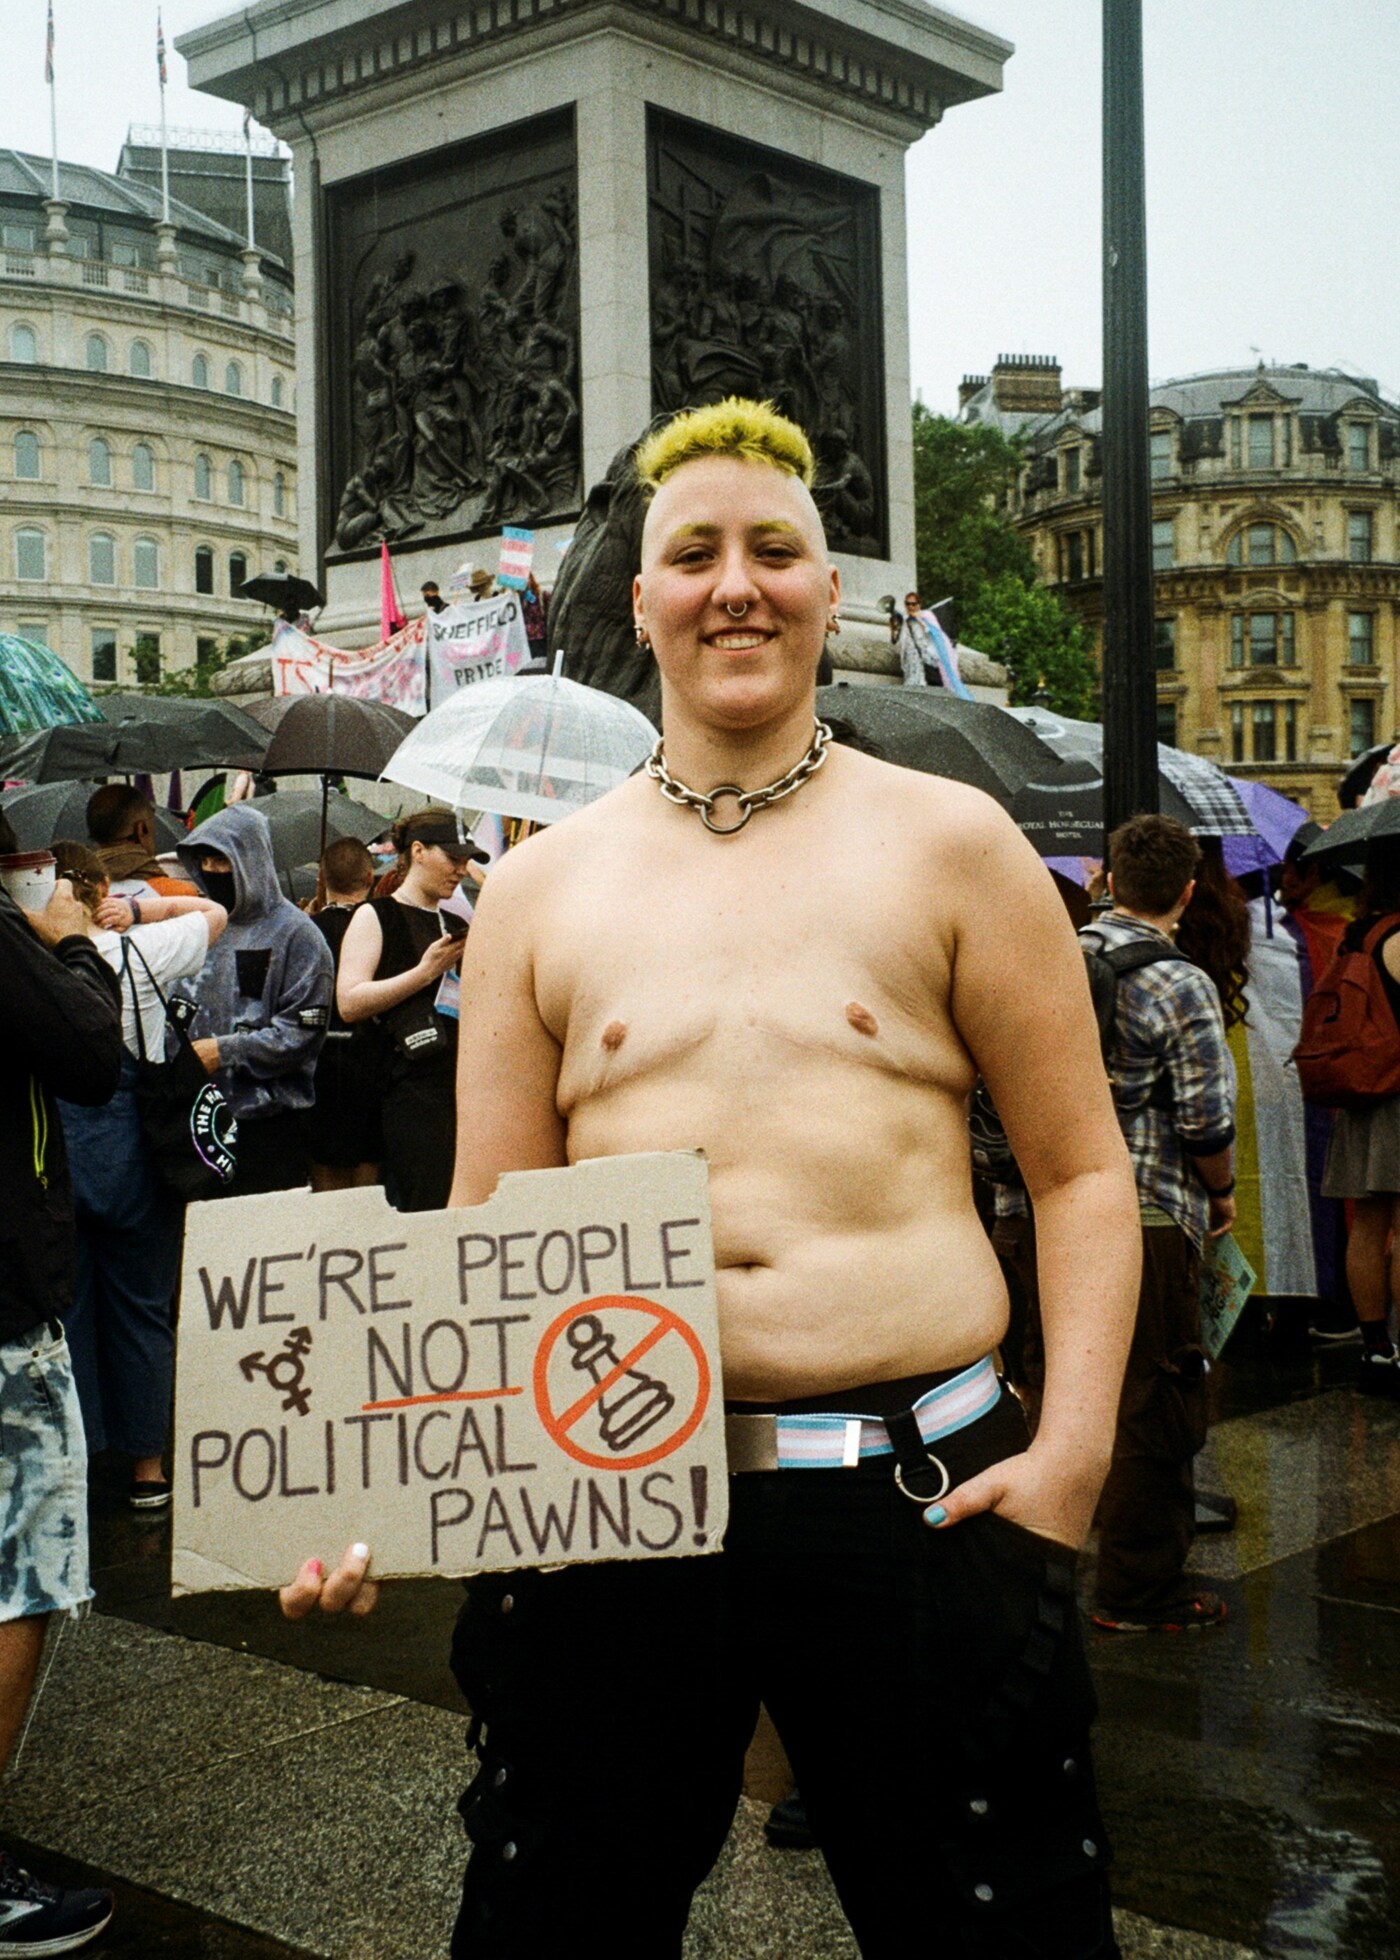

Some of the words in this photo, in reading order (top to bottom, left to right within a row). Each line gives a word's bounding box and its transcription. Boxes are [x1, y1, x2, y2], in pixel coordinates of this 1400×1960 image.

[433, 602, 517, 642] SHEFFIELD
[454, 658, 503, 686] PRIDE
[196, 1103, 212, 1136] THE
[197, 1242, 413, 1331] WE'RE
[456, 1217, 706, 1306] PEOPLE
[366, 1313, 532, 1403] NOT
[189, 1403, 538, 1508] POLITICAL
[429, 1463, 709, 1565] PAWNS!
